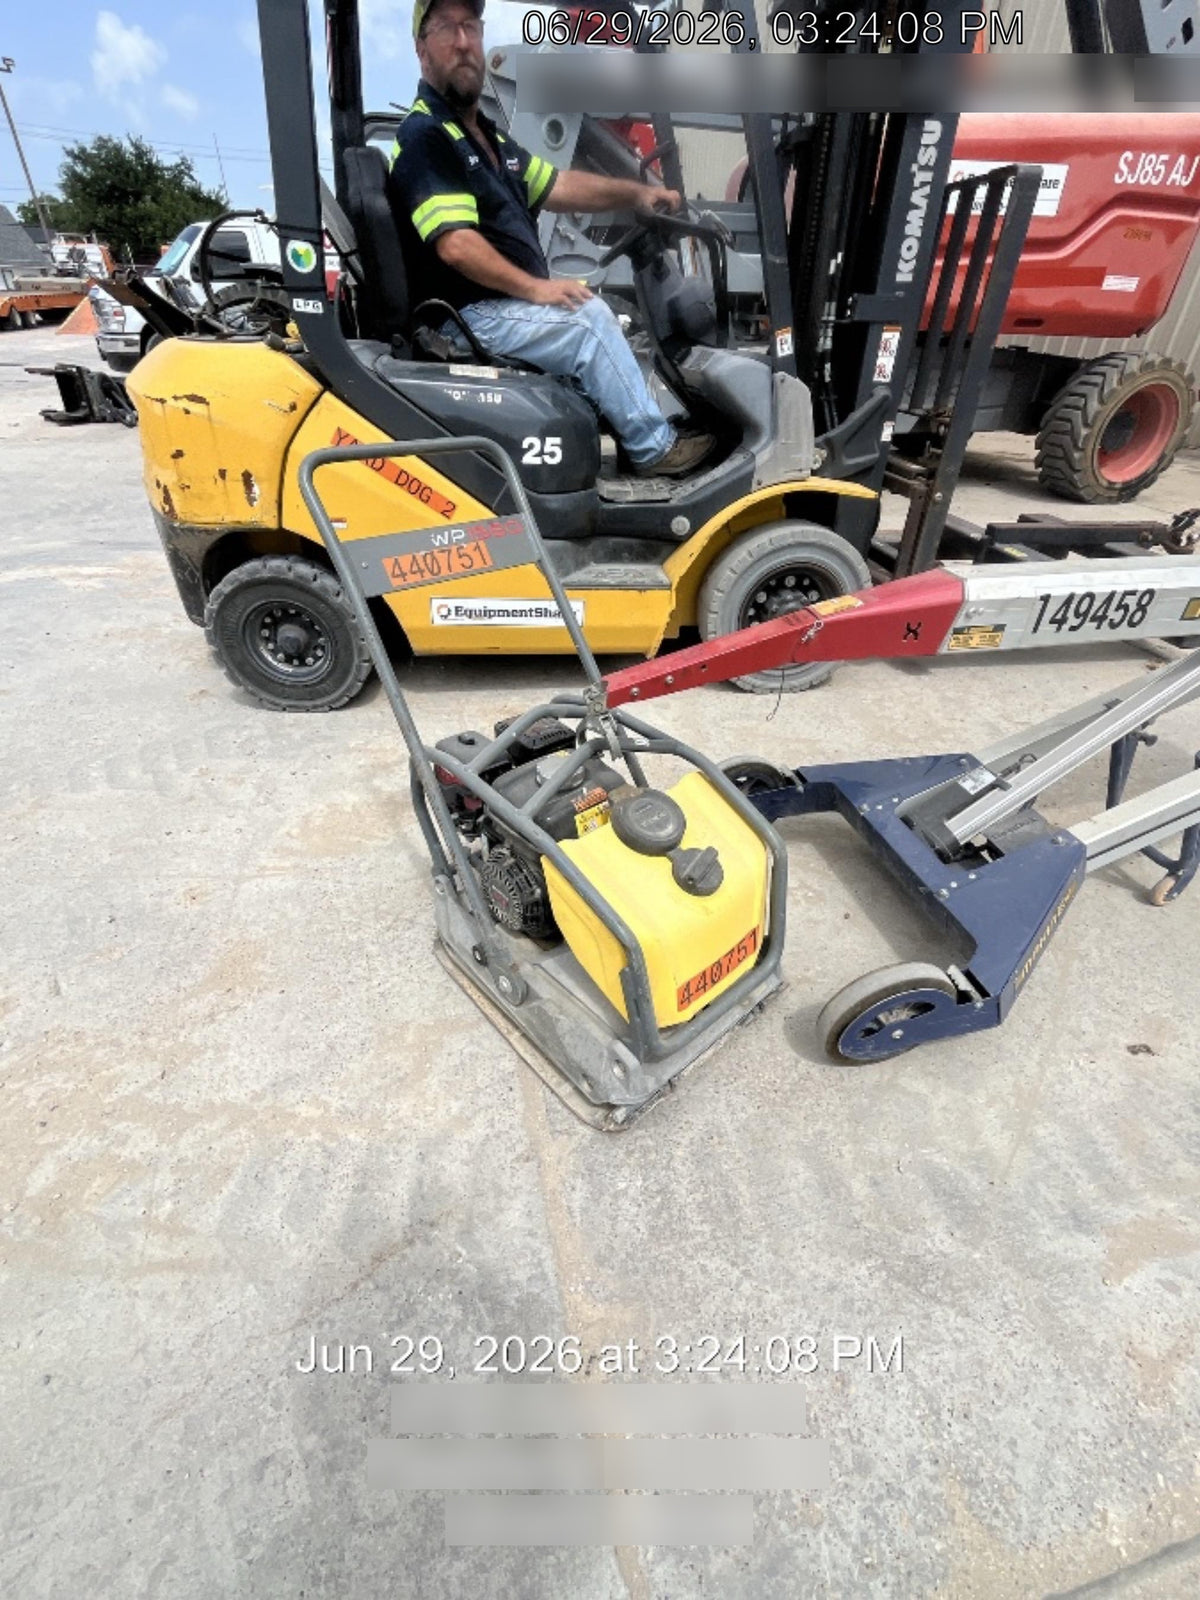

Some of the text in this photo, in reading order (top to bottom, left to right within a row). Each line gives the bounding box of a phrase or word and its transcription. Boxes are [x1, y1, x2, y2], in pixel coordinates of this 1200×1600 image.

[1114, 151, 1200, 187] SJ85 AJ
[896, 119, 942, 282] KOMATSU
[294, 299, 322, 312] LPG
[521, 436, 562, 465] 25
[393, 468, 433, 504] DOG
[440, 500, 457, 520] 2
[389, 541, 489, 583] 440751
[1031, 588, 1156, 635] 149458
[680, 926, 759, 1006] 440751
